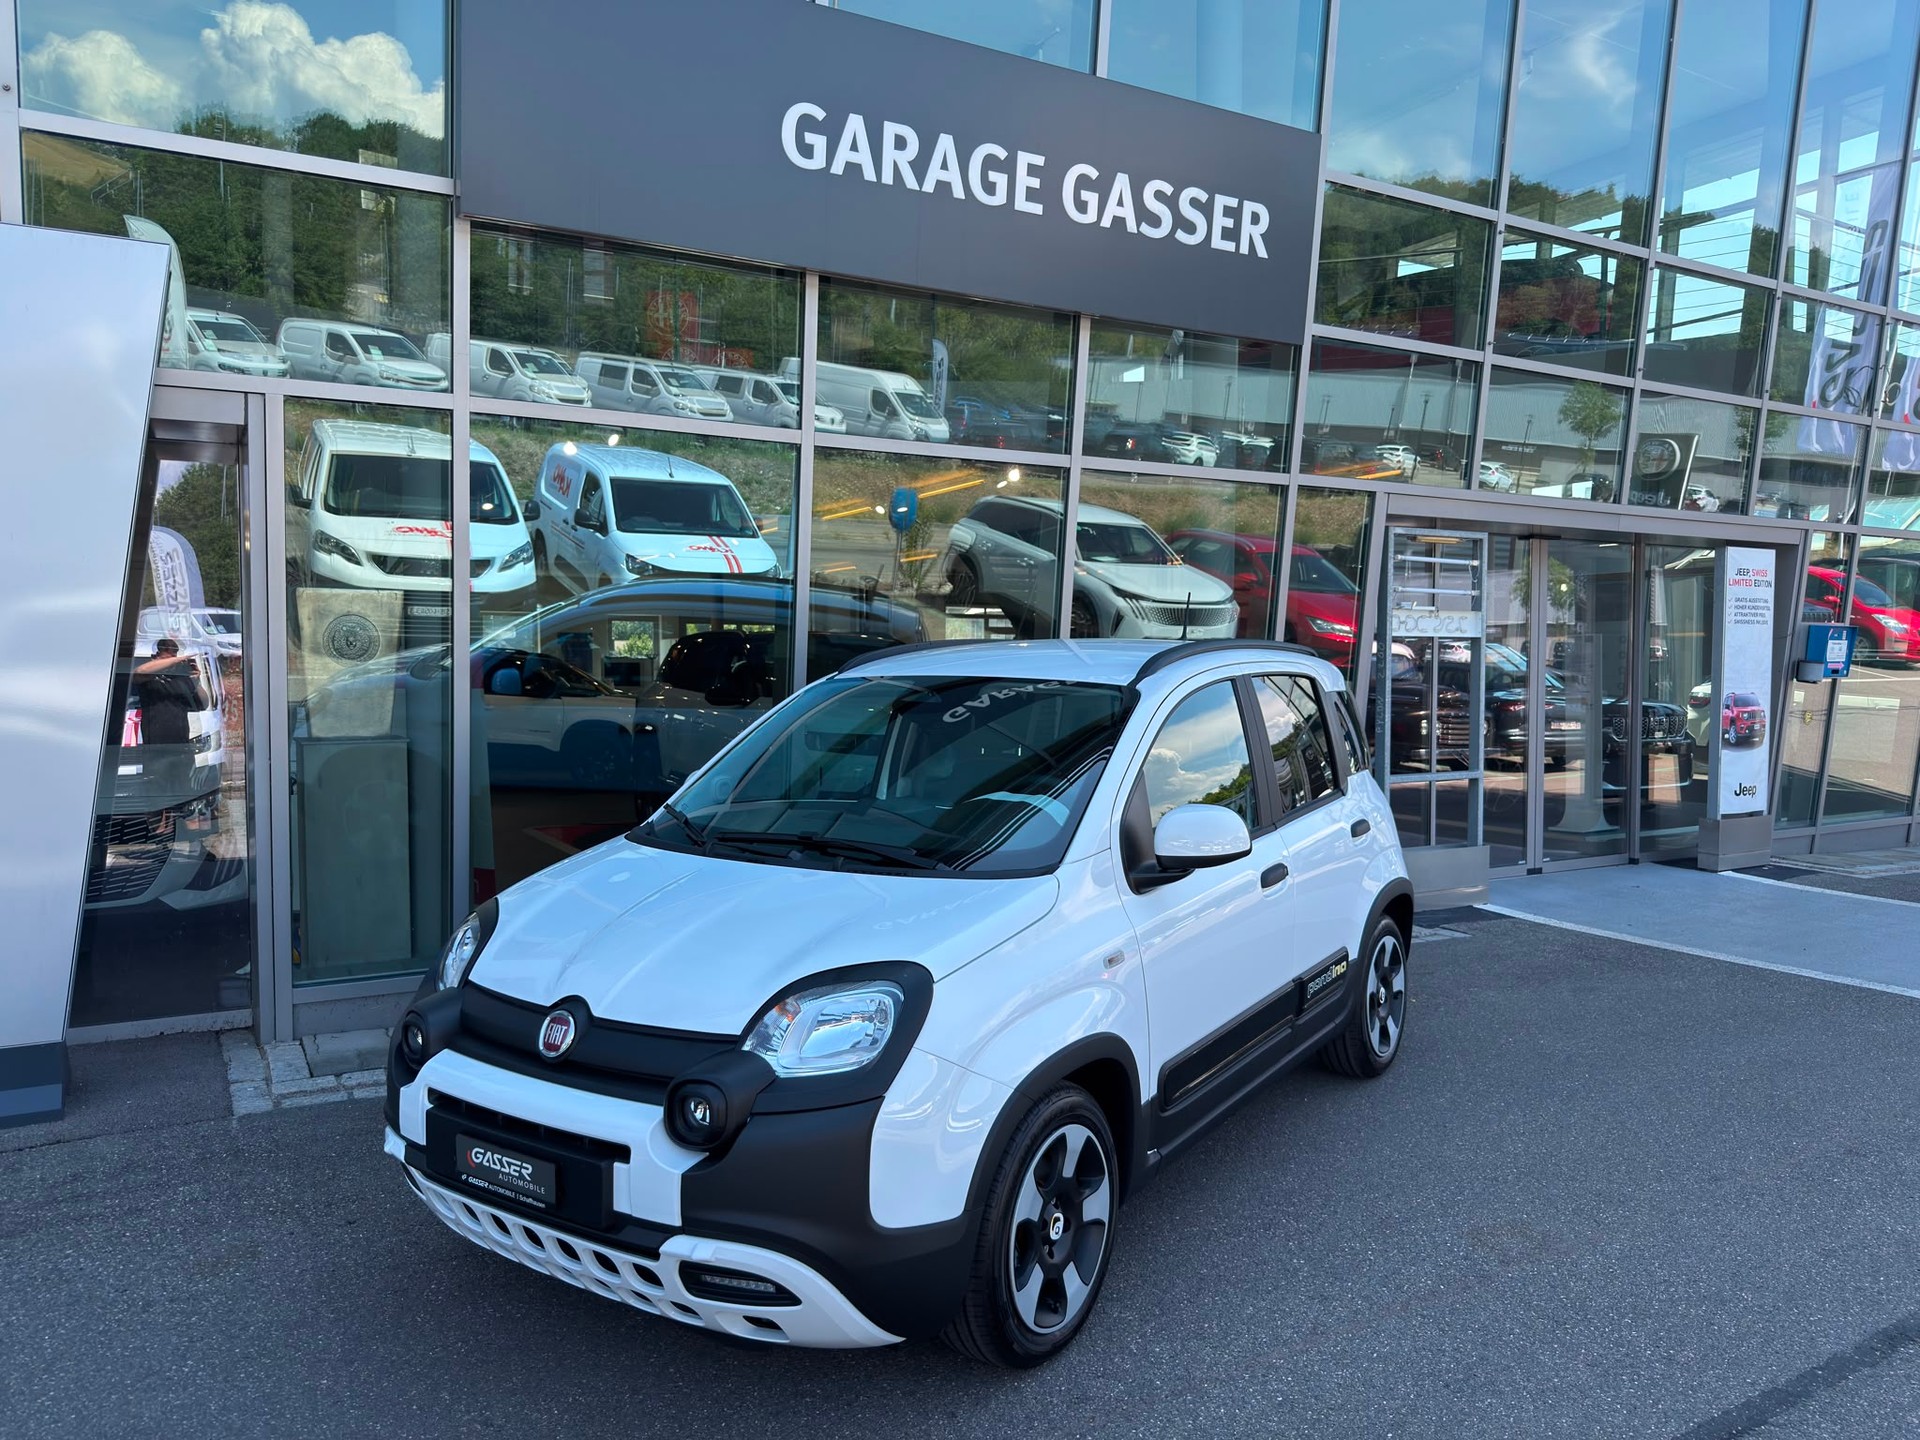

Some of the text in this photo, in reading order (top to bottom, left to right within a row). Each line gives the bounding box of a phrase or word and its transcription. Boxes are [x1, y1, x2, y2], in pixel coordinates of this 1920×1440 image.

[781, 102, 1270, 259] GARAGE GASSER
[1728, 578, 1772, 588] LIMITED EDITION
[1751, 569, 1768, 578] SWISS
[1734, 782, 1757, 798] Jeep
[1307, 960, 1347, 999] pandina
[545, 1022, 568, 1046] FIAT
[471, 1147, 534, 1181] GASSER
[468, 1176, 546, 1208] GASSER AUTOMOBILE Schaffhausen
[498, 1173, 546, 1195] AUTOMOBILE
